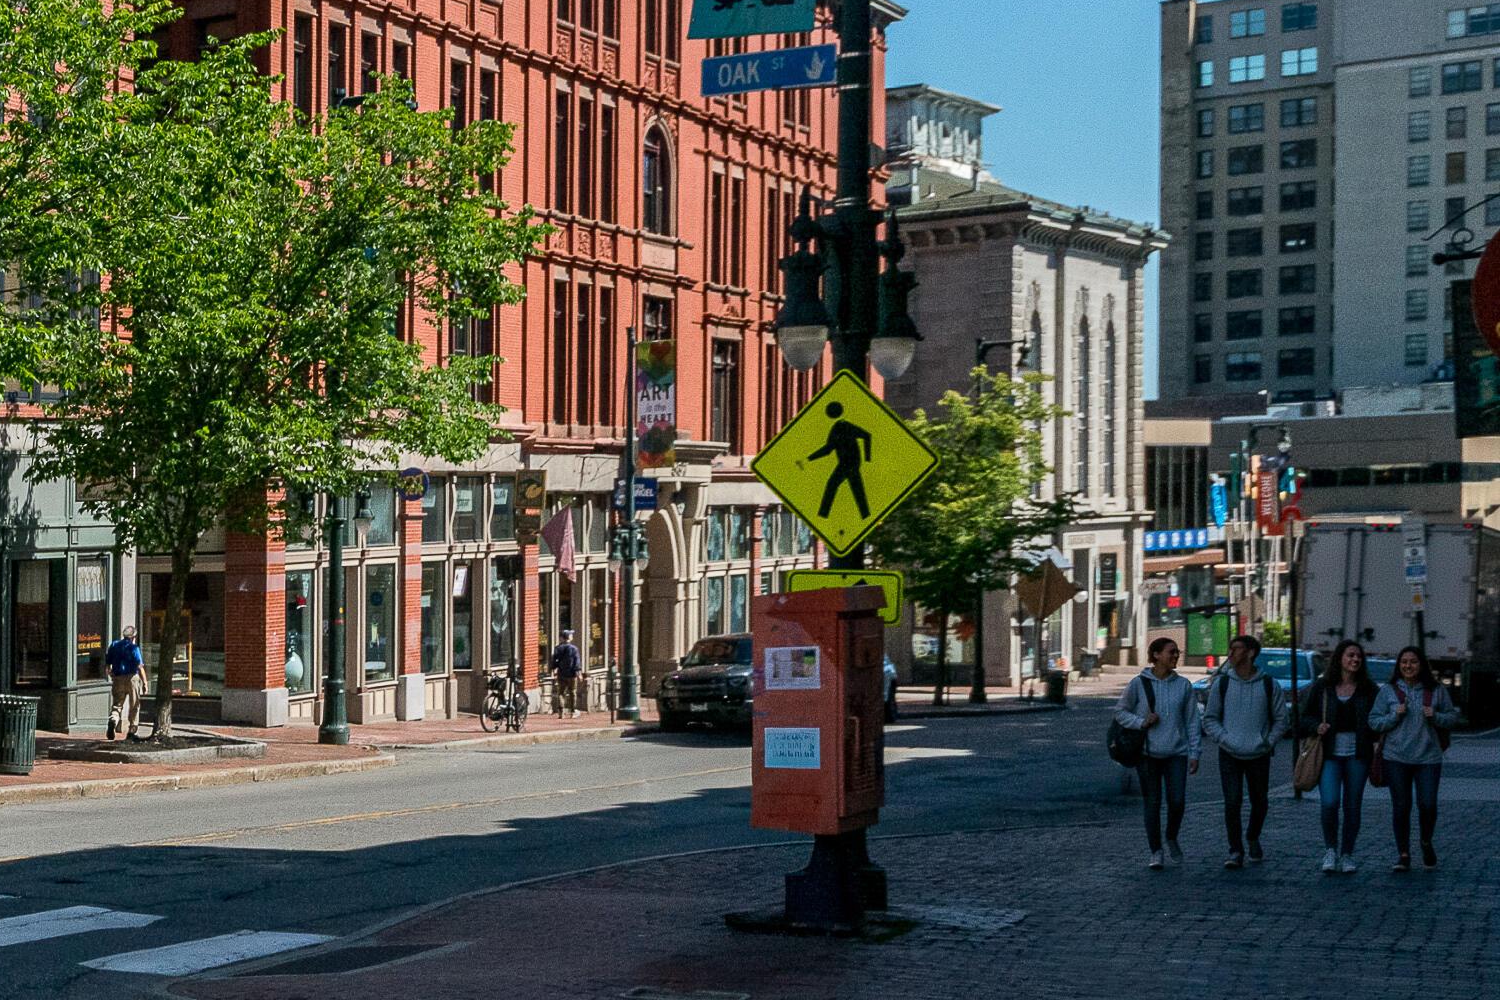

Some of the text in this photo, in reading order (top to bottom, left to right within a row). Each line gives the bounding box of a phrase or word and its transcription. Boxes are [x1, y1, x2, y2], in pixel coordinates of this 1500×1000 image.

[718, 55, 786, 88] OAK ST
[640, 383, 672, 401] ART
[640, 413, 672, 423] HEART
